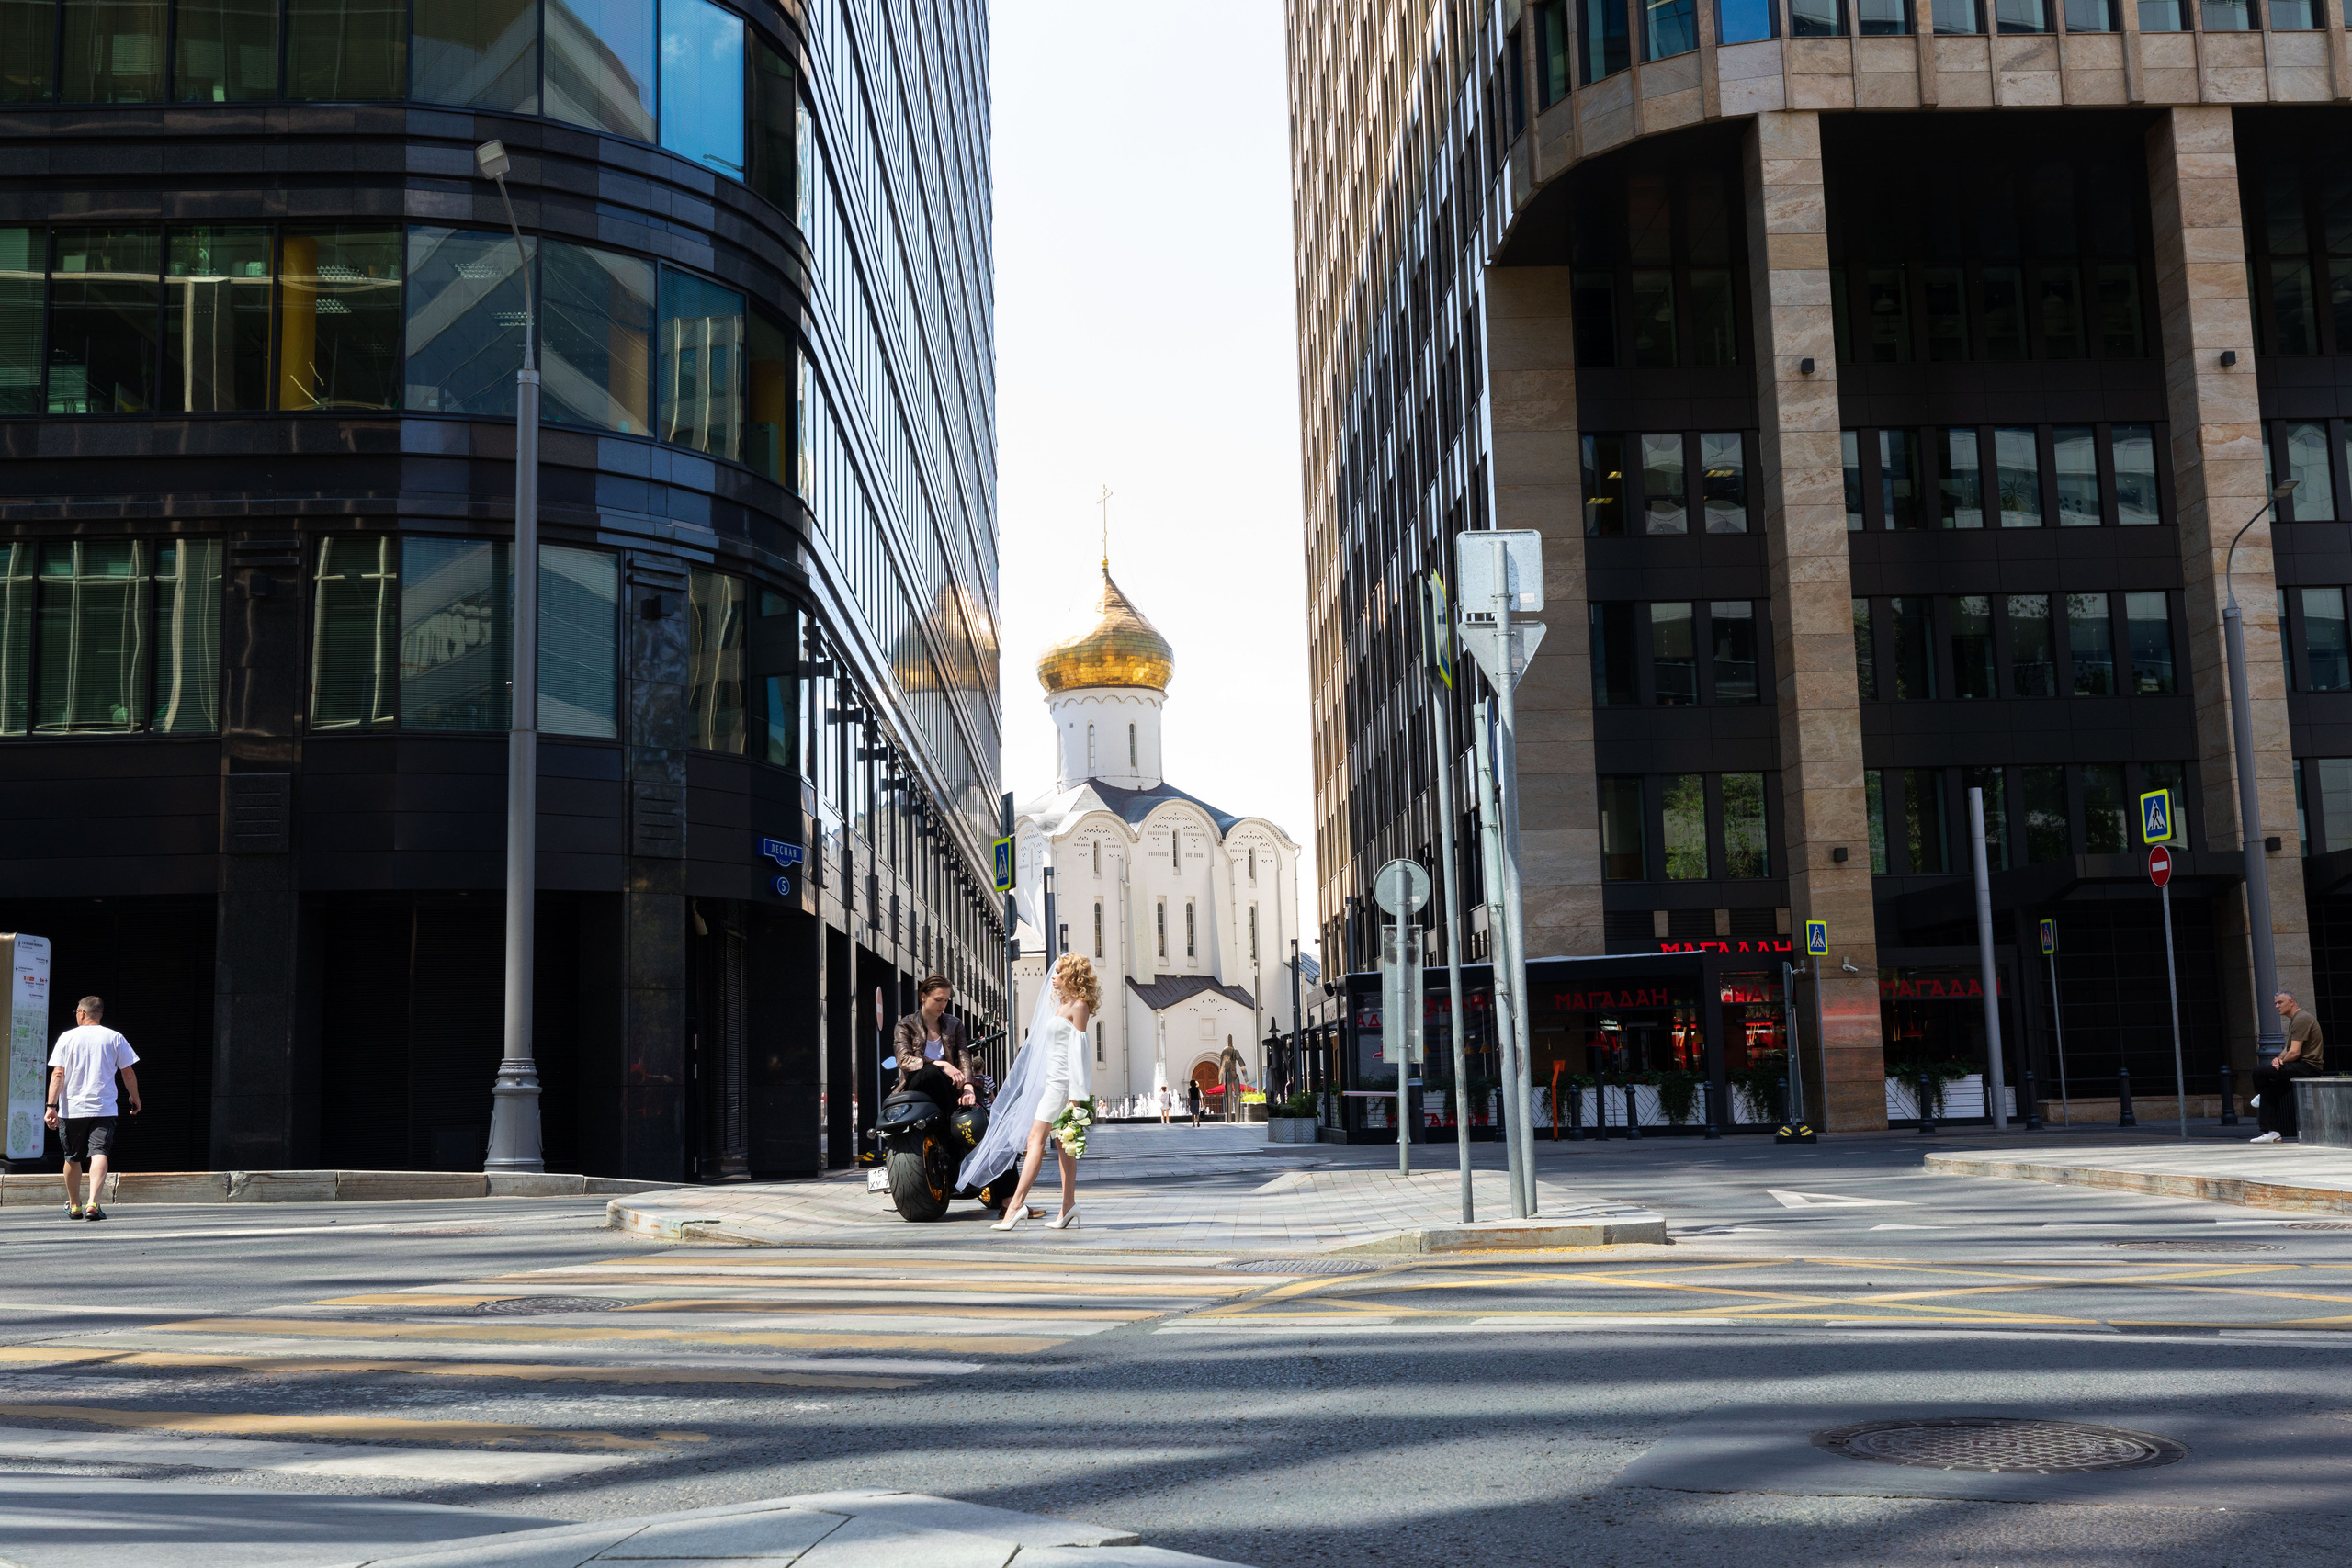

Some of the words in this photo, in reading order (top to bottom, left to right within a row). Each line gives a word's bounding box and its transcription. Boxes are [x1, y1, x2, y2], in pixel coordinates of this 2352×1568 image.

[771, 843, 797, 858] ЛЕСНАЯ
[781, 880, 786, 892] 5
[1879, 978, 2002, 998] МАГАДА
[1555, 987, 1668, 1011] МАГАДАН
